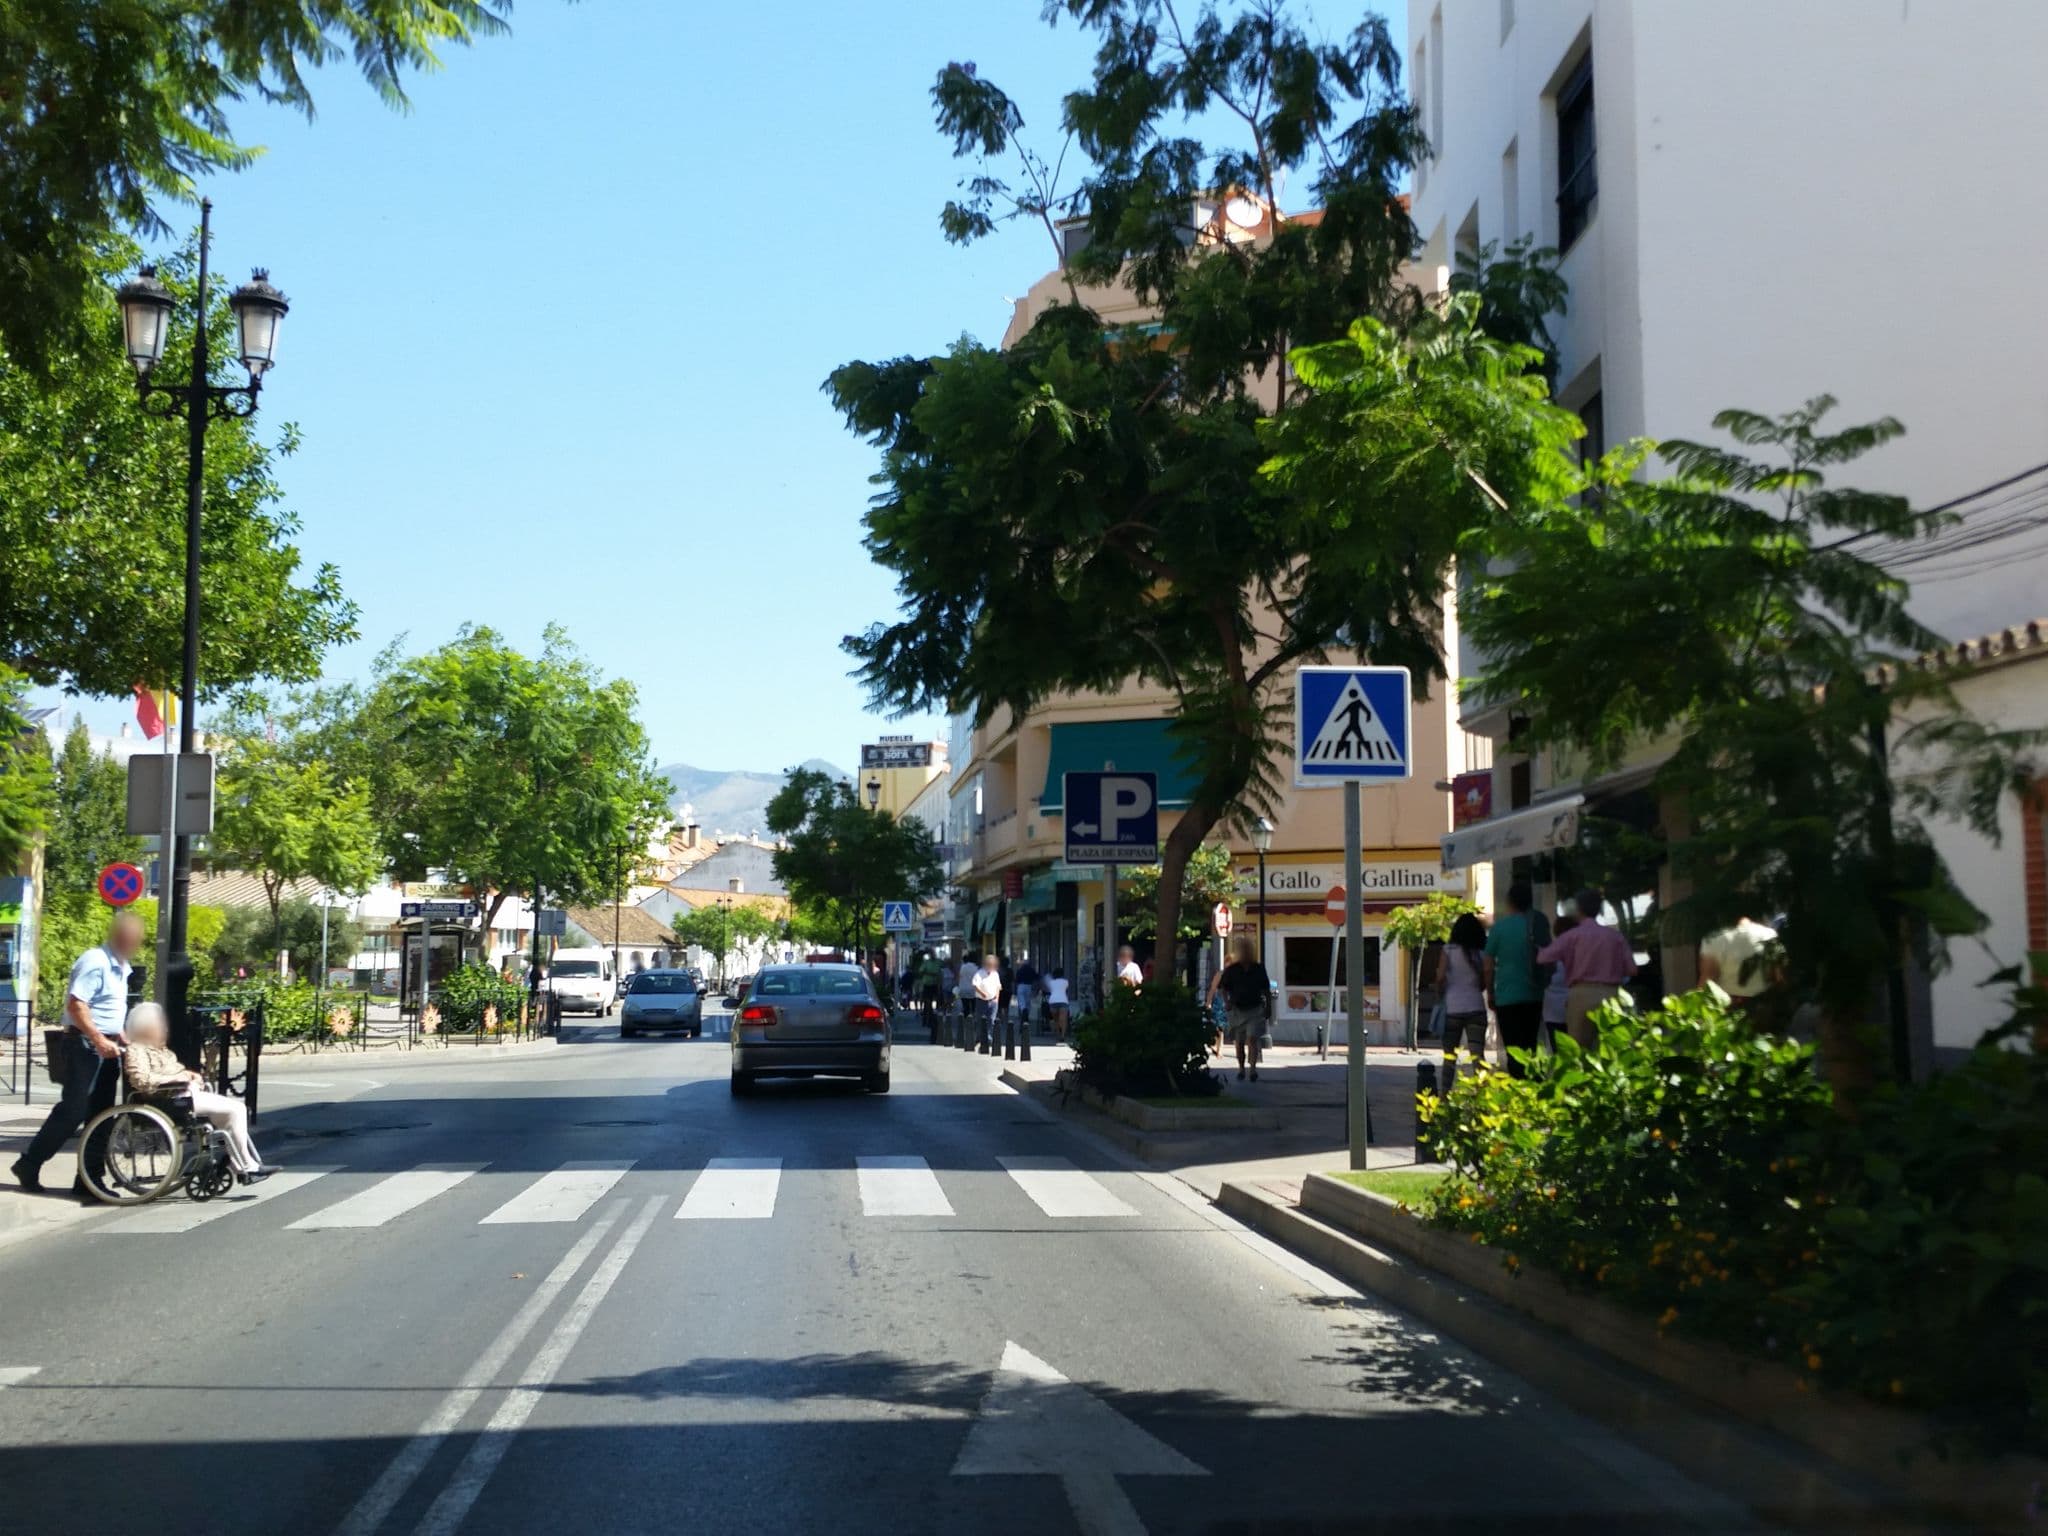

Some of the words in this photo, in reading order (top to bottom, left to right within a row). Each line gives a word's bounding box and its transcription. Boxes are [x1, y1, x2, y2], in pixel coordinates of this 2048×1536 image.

[1100, 777, 1152, 841] P
[1069, 848, 1100, 858] PLAZA
[1102, 848, 1115, 858] DE
[1117, 847, 1155, 858] ESPAÑA
[1269, 871, 1321, 890] Gallo
[1362, 868, 1435, 888] Gallina
[420, 904, 461, 912] PARKING
[463, 904, 476, 917] P
